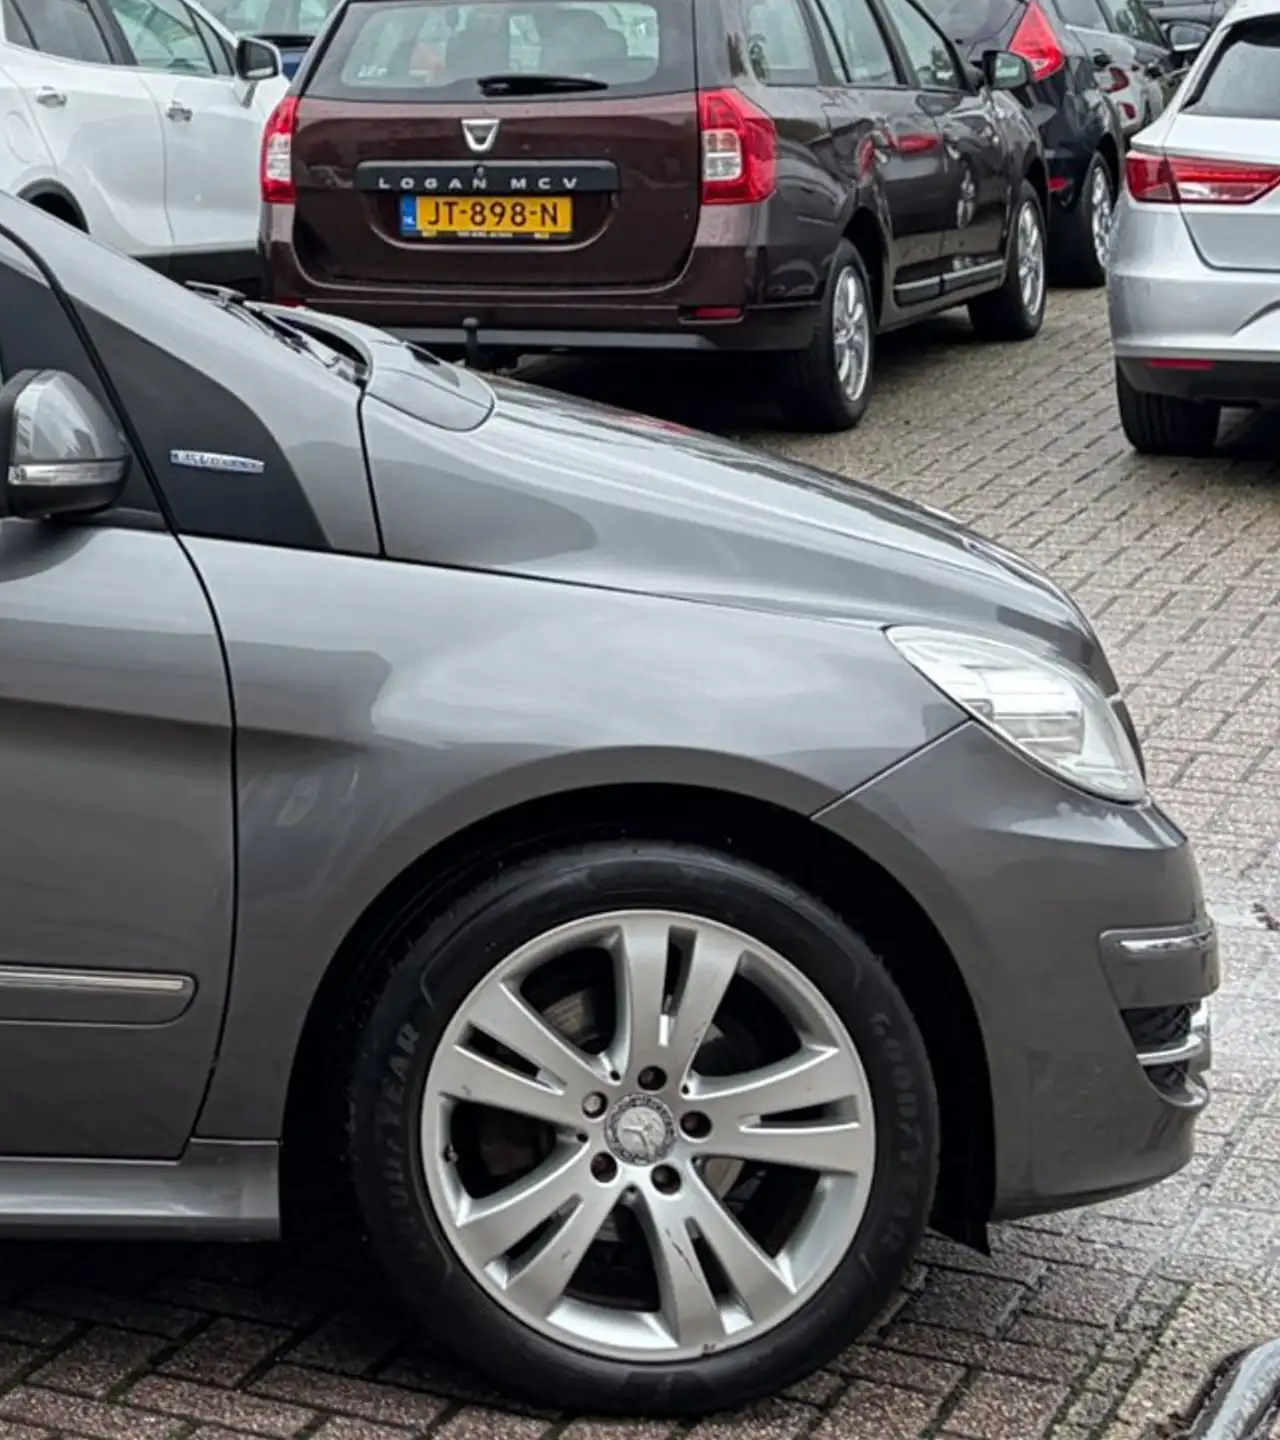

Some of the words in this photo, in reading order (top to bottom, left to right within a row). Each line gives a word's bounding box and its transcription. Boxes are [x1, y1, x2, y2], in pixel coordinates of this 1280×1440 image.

[378, 176, 487, 189] LOGAN
[510, 176, 578, 189] MCV
[427, 201, 558, 227] JT-898-N
